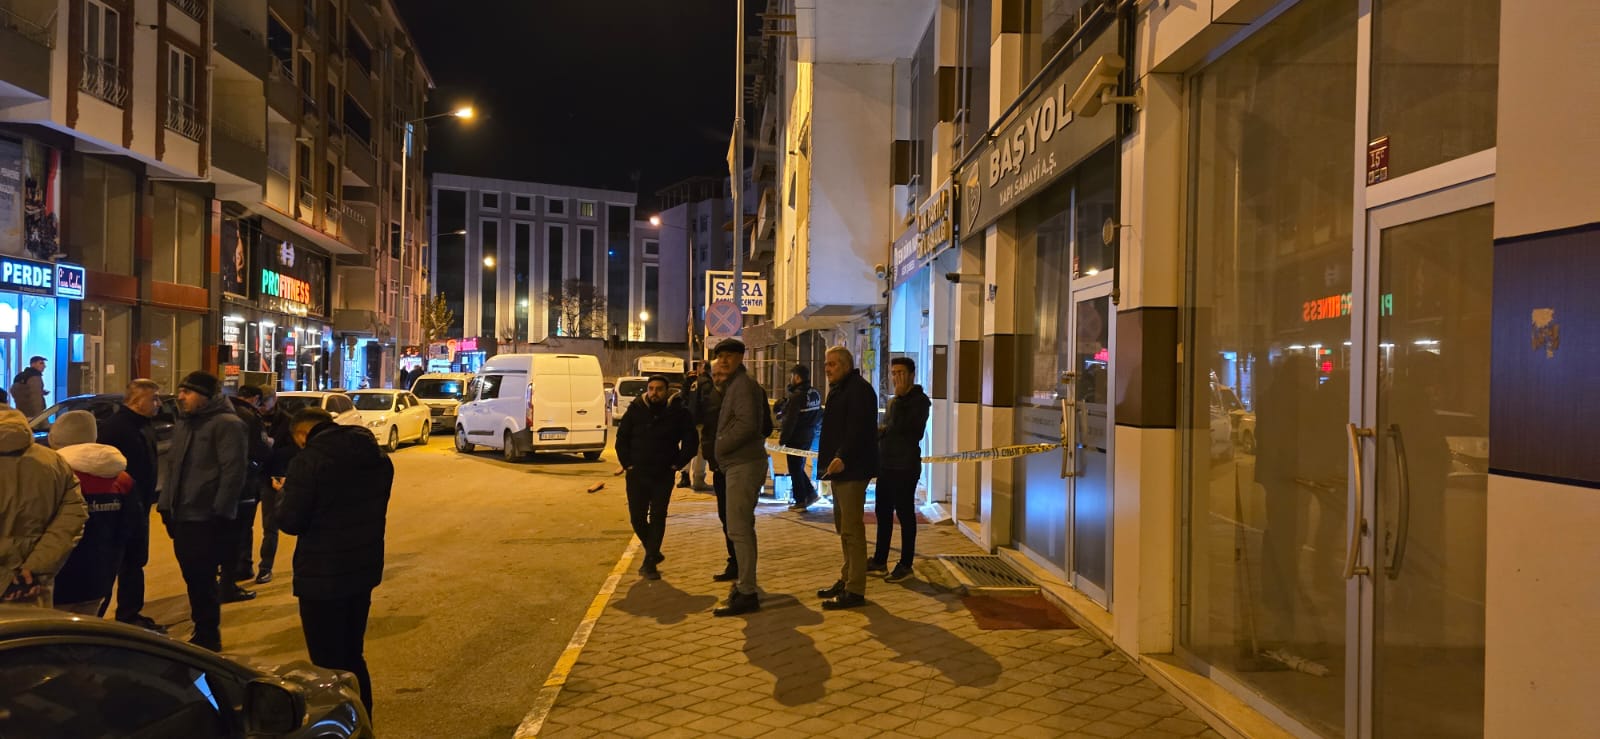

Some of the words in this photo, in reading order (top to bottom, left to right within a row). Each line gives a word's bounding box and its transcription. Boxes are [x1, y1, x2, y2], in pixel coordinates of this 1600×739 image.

[989, 84, 1073, 188] BAŞYOL
[1000, 184, 1013, 206] YAPI
[3, 262, 52, 288] PERDE
[262, 268, 310, 305] PROFITNESS
[716, 282, 763, 296] SARA
